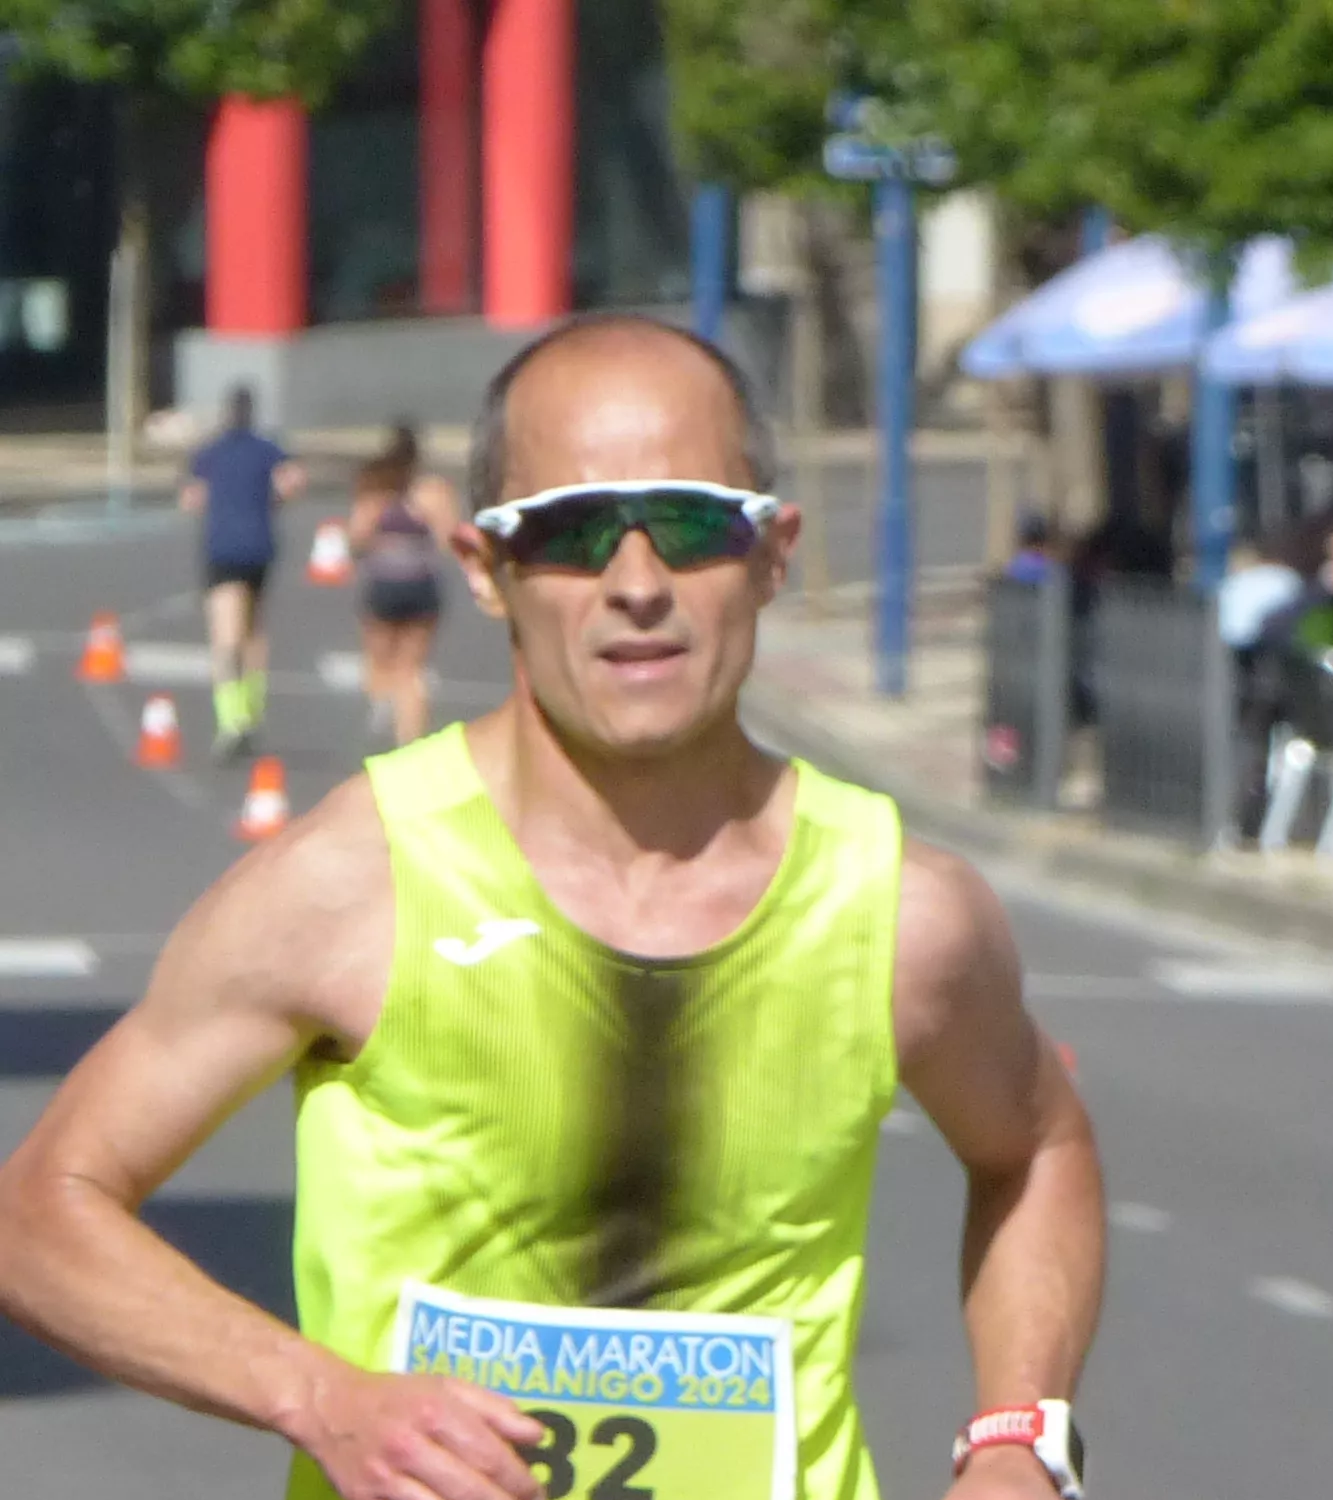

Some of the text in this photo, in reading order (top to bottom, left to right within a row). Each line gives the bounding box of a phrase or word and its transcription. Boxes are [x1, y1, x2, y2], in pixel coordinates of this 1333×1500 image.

[413, 1309, 772, 1379] MEDIA MARATON
[677, 1374, 770, 1407] 2024
